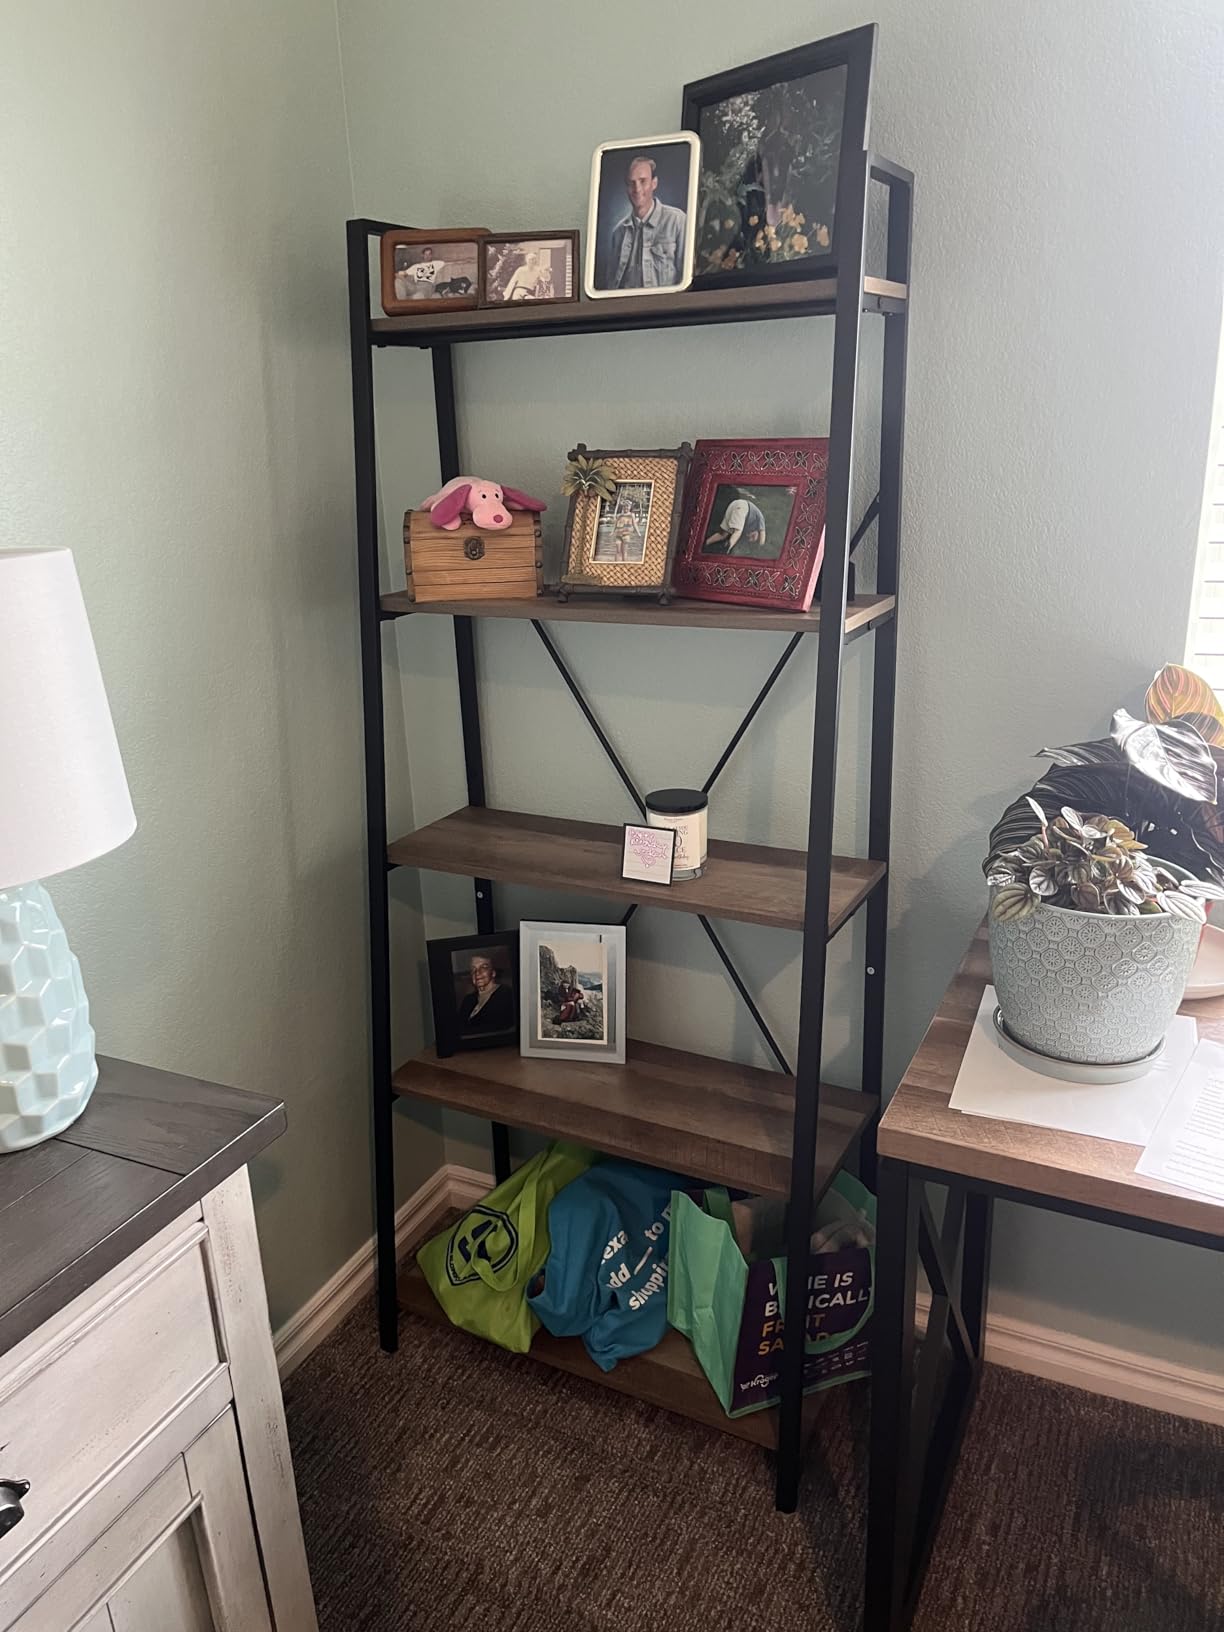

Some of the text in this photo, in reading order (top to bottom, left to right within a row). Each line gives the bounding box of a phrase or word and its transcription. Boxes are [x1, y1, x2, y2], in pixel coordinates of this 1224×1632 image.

[601, 1230, 629, 1264] exa
[606, 1222, 665, 1288] dd to
[833, 1271, 854, 1288] IS
